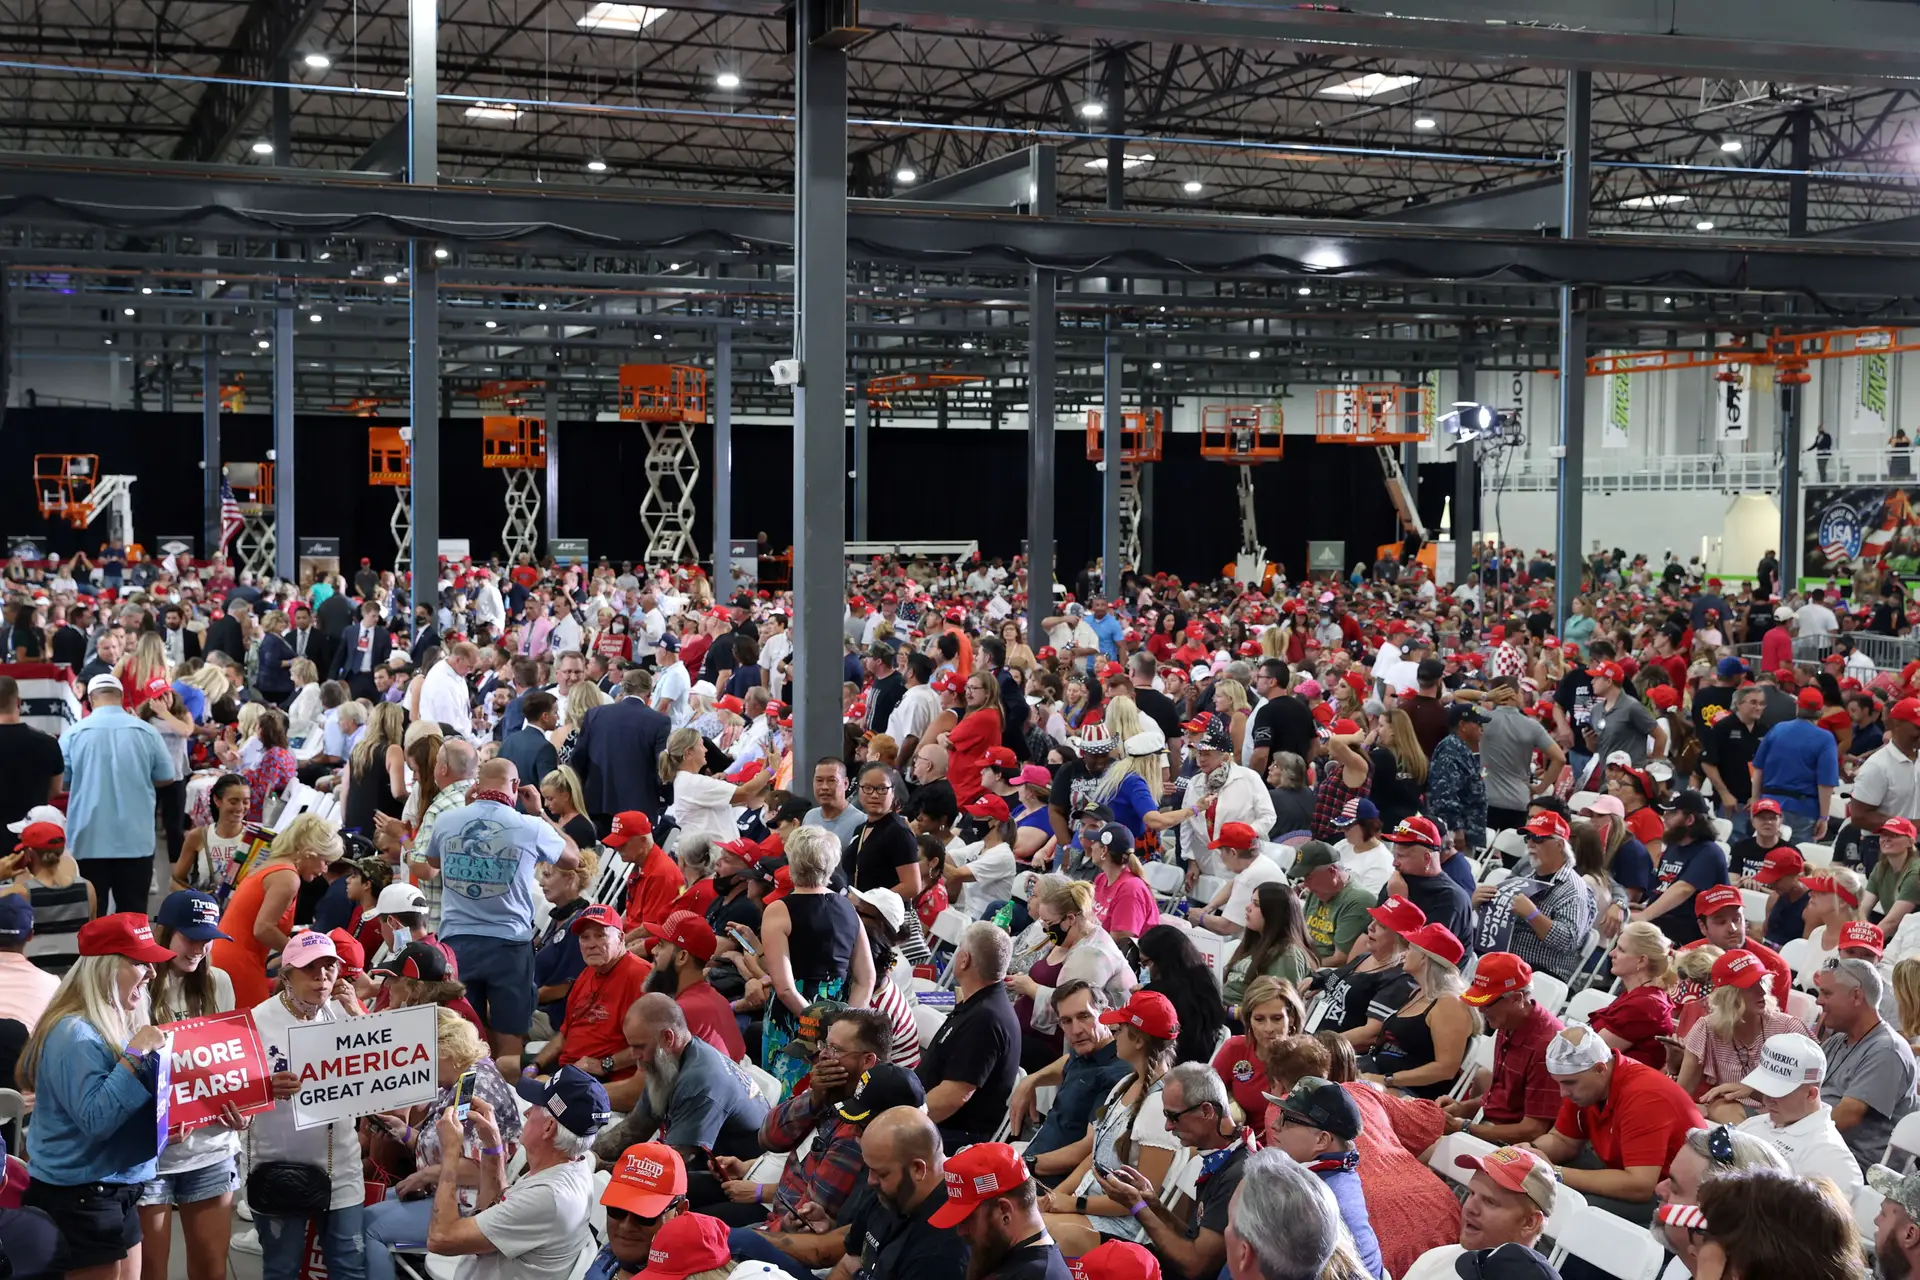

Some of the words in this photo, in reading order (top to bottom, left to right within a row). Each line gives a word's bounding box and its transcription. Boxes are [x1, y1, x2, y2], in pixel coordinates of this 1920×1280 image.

[1828, 525, 1852, 542] USA
[336, 1028, 392, 1051] MAKE
[172, 1038, 245, 1073] MORE
[299, 1043, 430, 1084] AMERICA
[1769, 1063, 1792, 1077] AGAIN
[300, 1081, 364, 1106] GREAT
[371, 1068, 430, 1093] AGAIN
[199, 1114, 217, 1123] 2020
[627, 1154, 663, 1179] Trump
